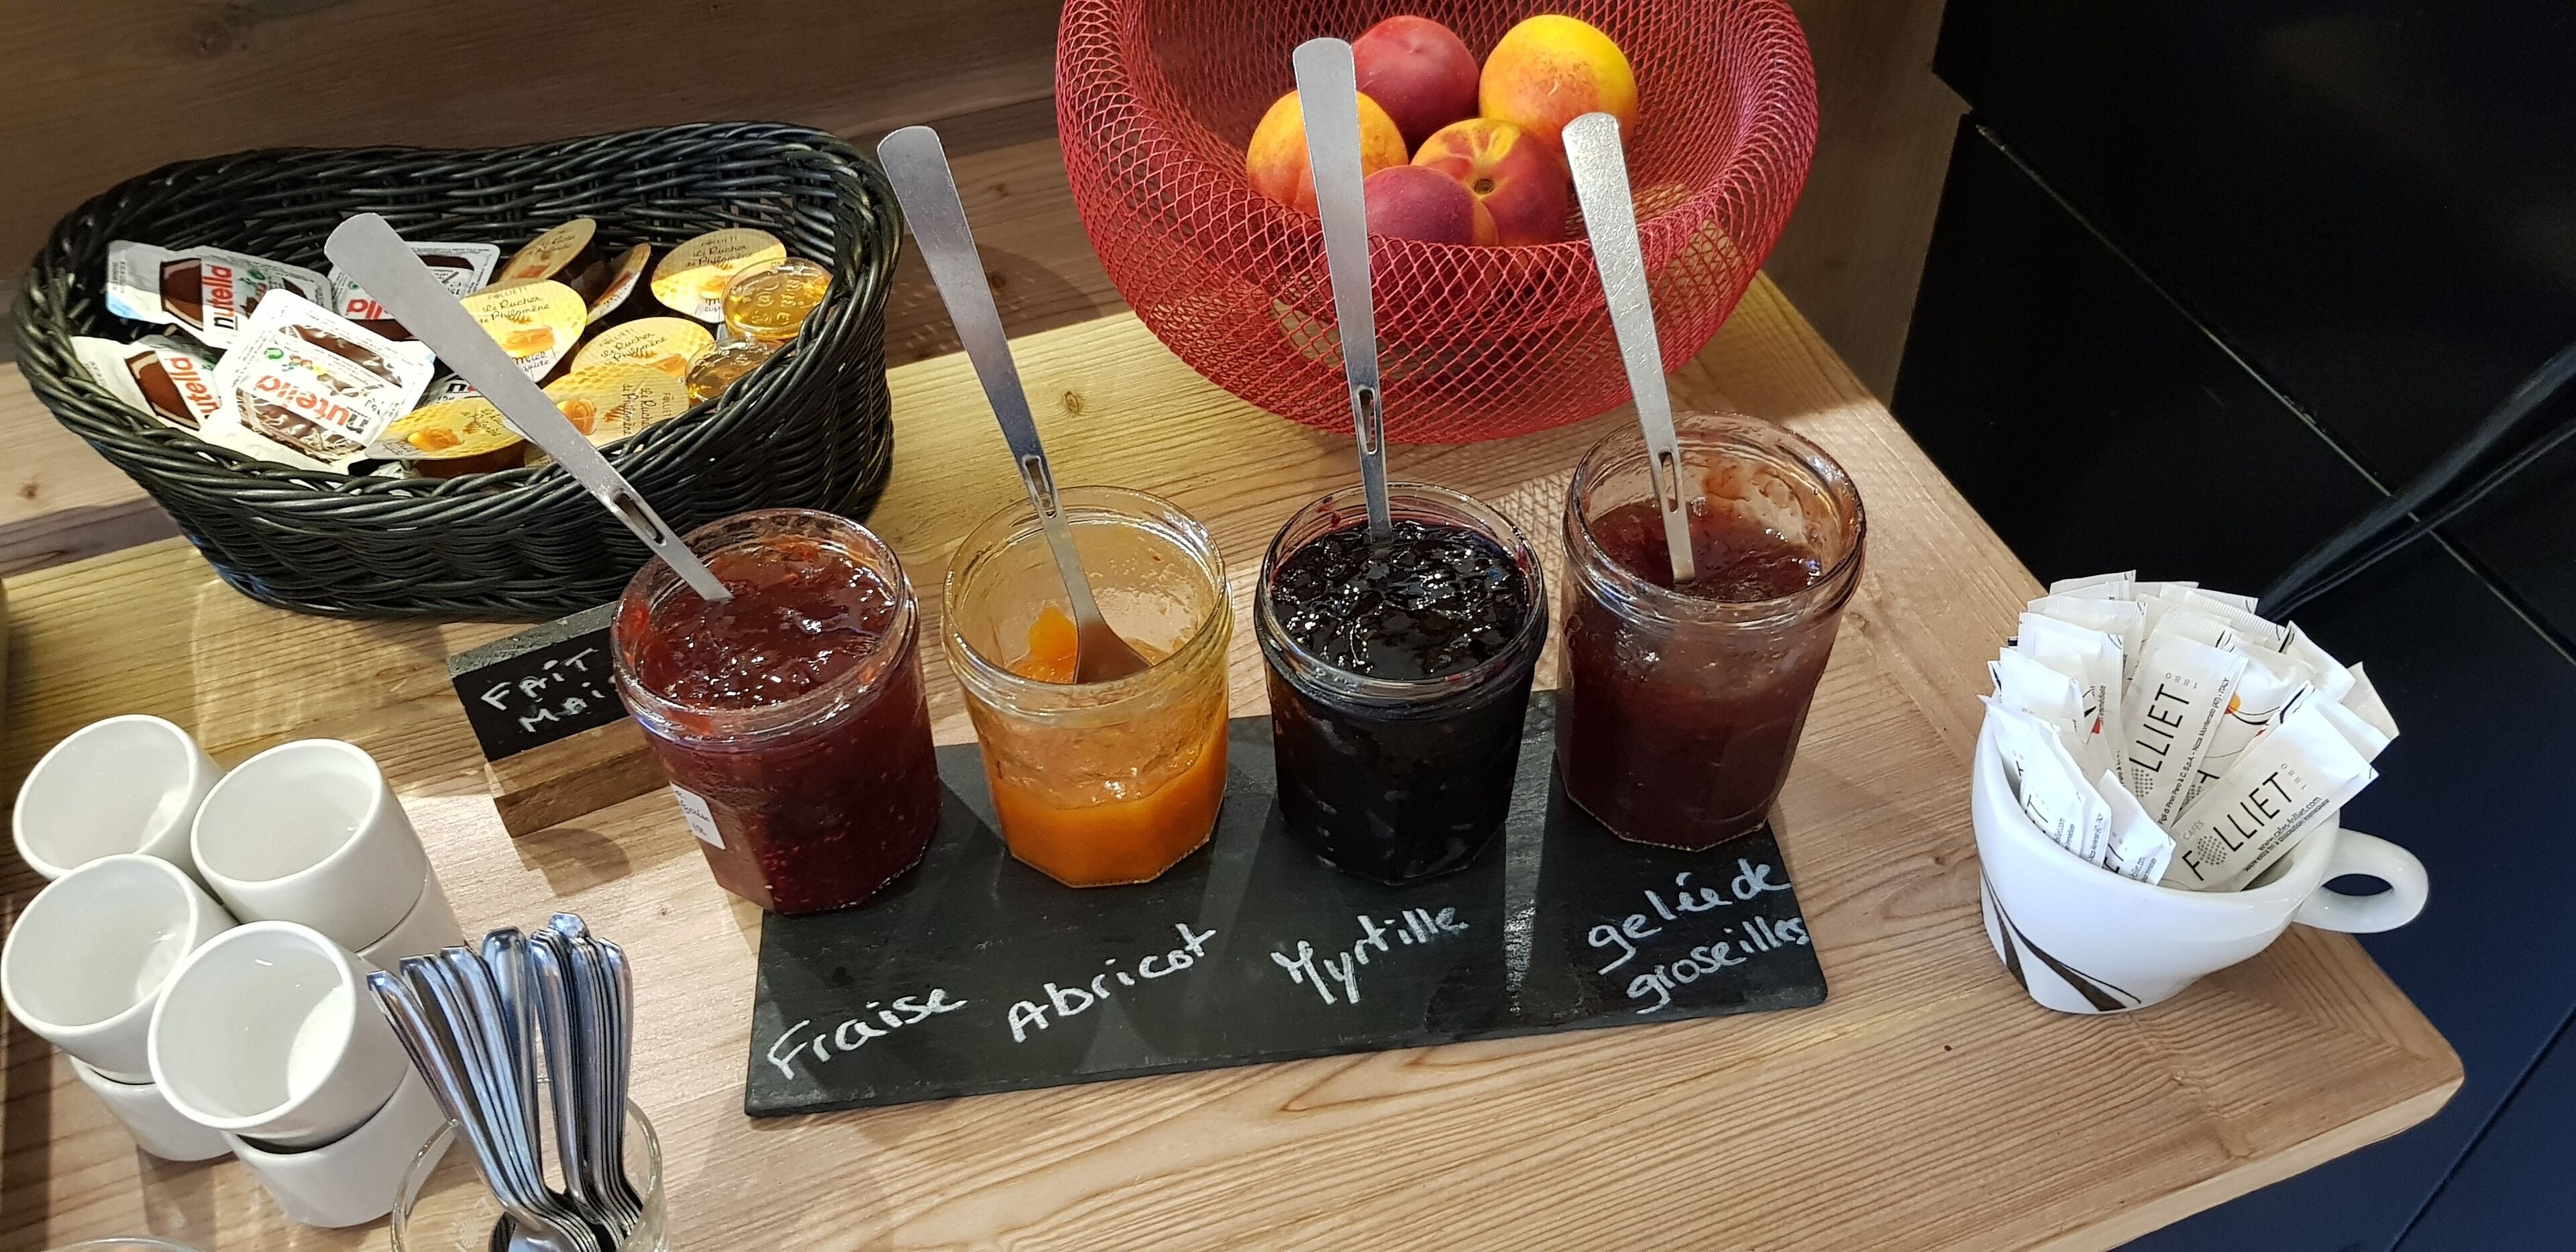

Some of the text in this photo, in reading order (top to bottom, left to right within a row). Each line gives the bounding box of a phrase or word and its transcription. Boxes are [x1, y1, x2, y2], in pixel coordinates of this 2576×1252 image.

[709, 245, 746, 255] Rucher
[202, 265, 234, 330] nutella
[491, 303, 551, 321] Philomène
[499, 297, 542, 309] Rucher
[615, 333, 655, 350] Rucher
[256, 375, 369, 435] nutella
[1008, 923, 1217, 1043] Abricot
[1270, 906, 1470, 1005] Myrtille
[1626, 915, 1811, 1015] groseilles
[767, 988, 970, 1080] Fraise
